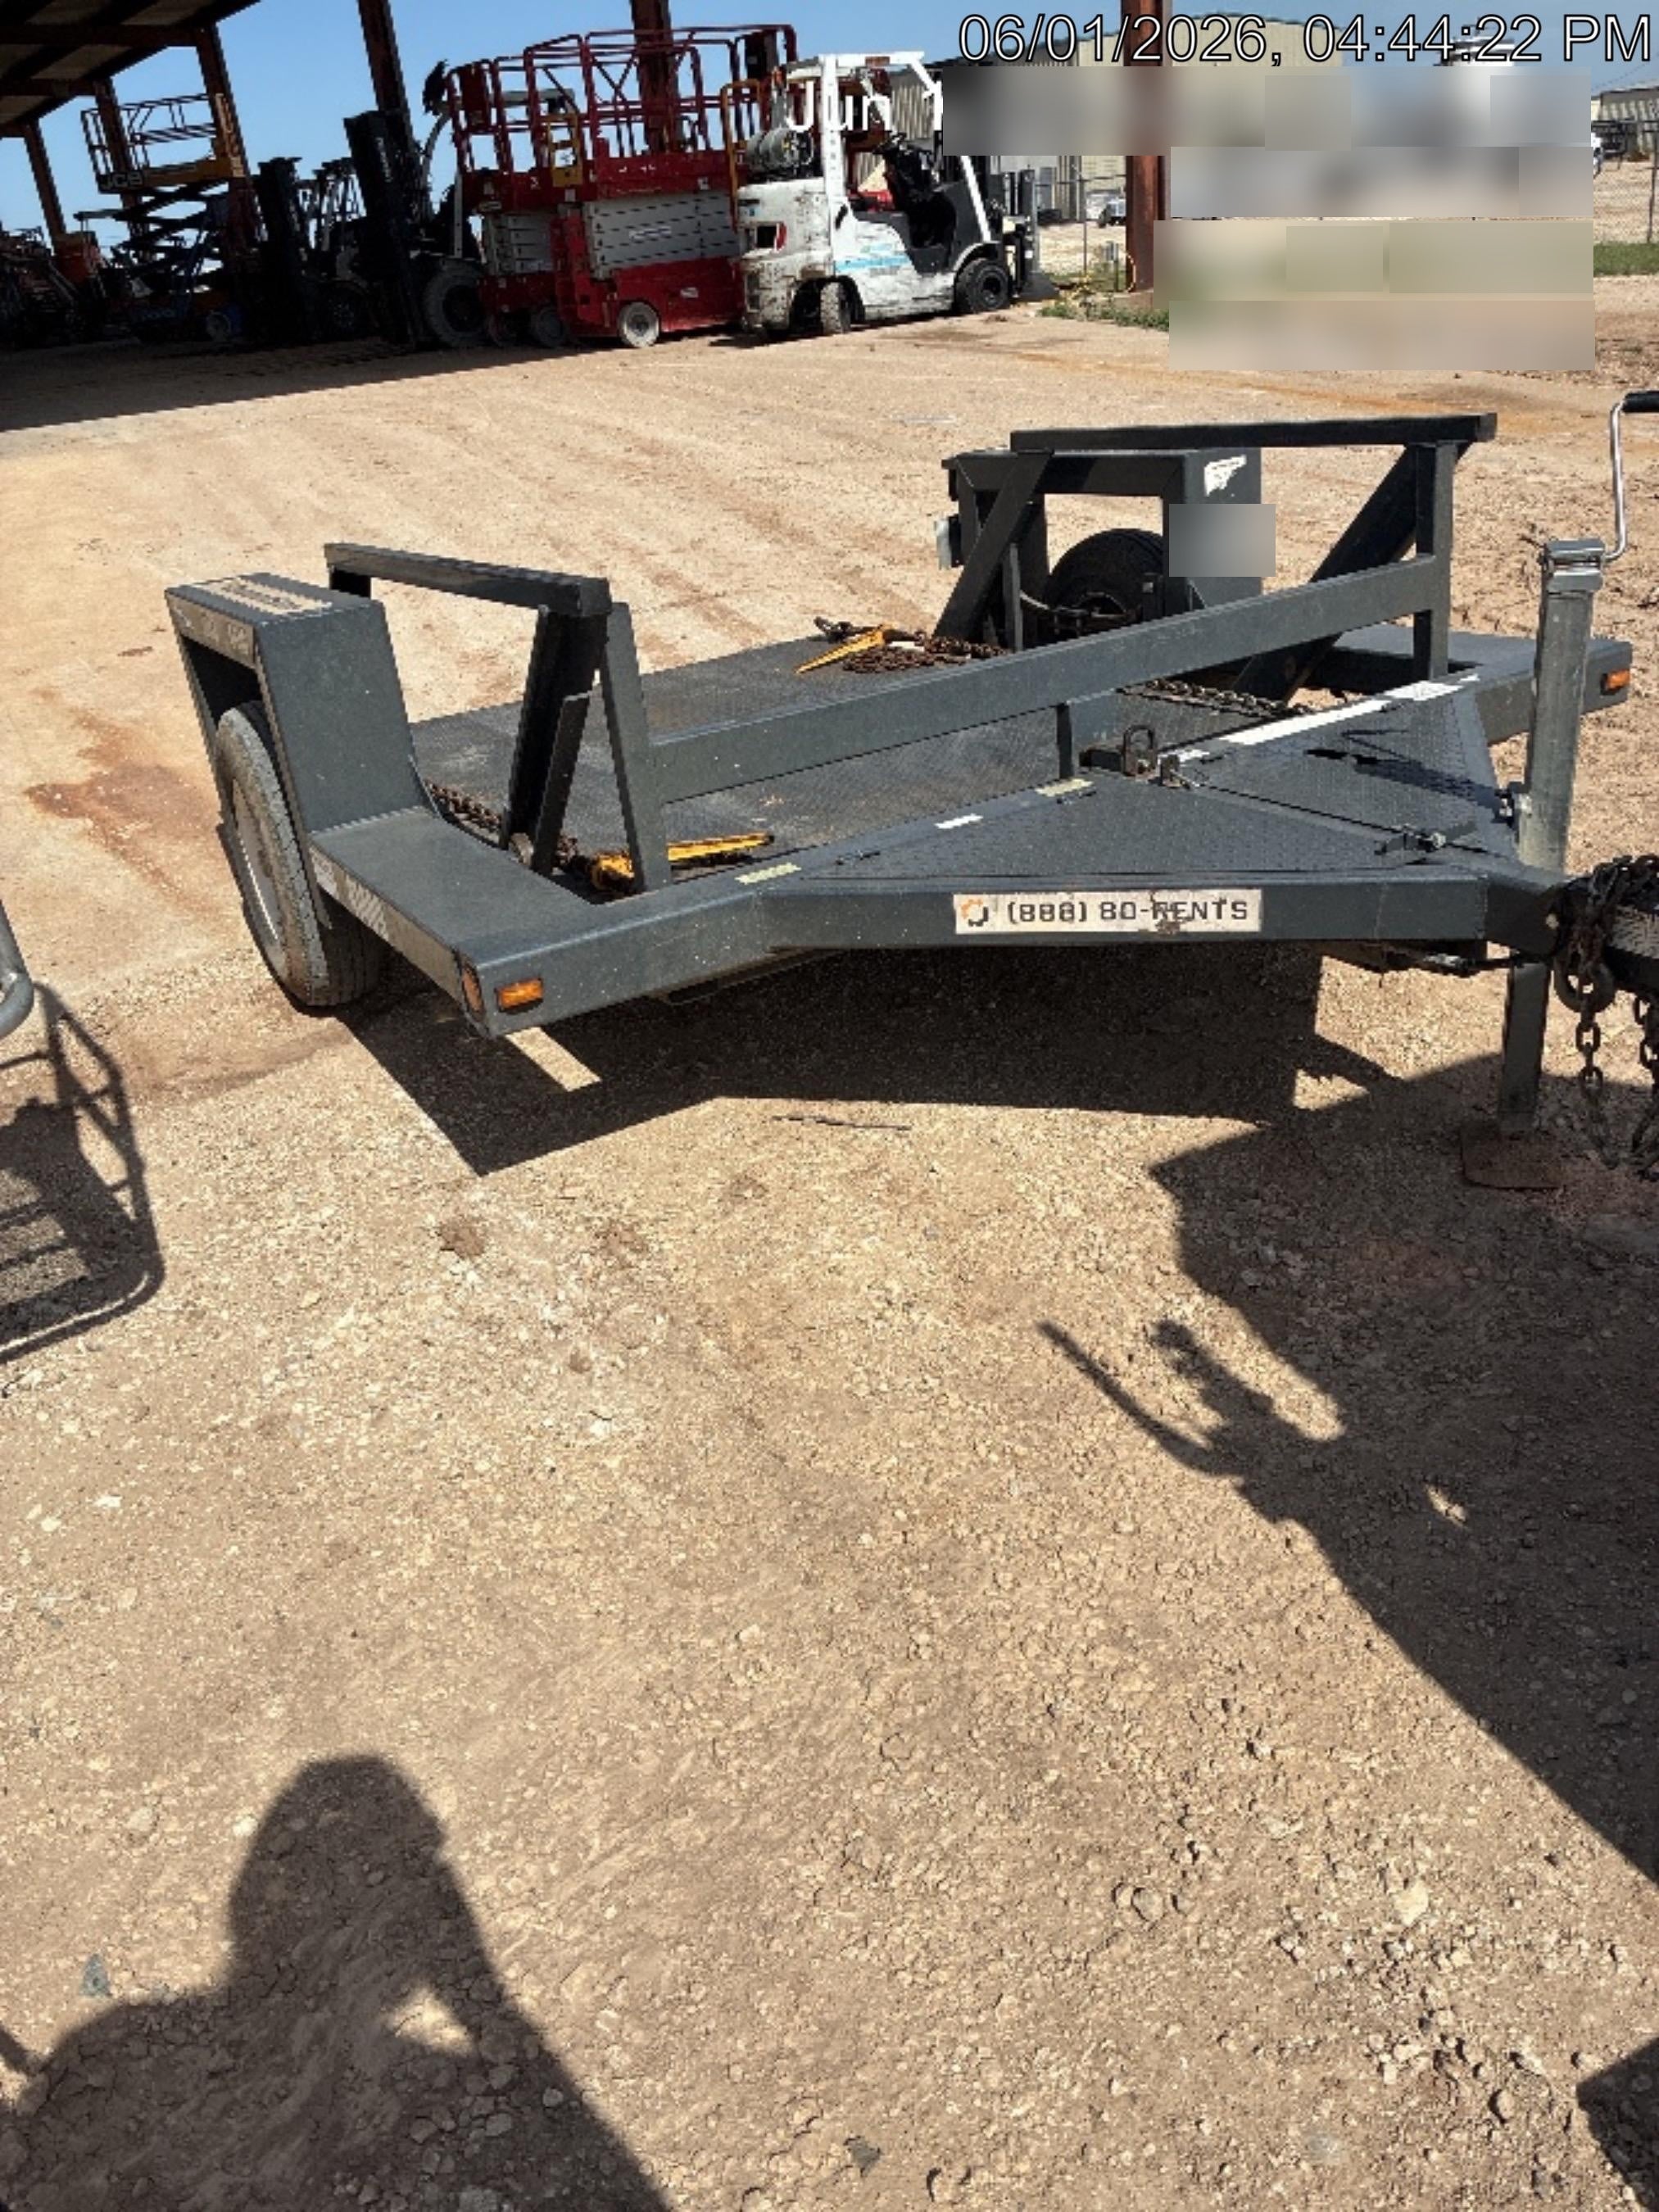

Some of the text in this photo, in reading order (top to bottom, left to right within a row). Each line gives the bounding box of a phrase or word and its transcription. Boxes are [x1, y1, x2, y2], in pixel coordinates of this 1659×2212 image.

[99, 170, 144, 191] JCB
[1007, 900, 1248, 924] (888) 80-RENTS
